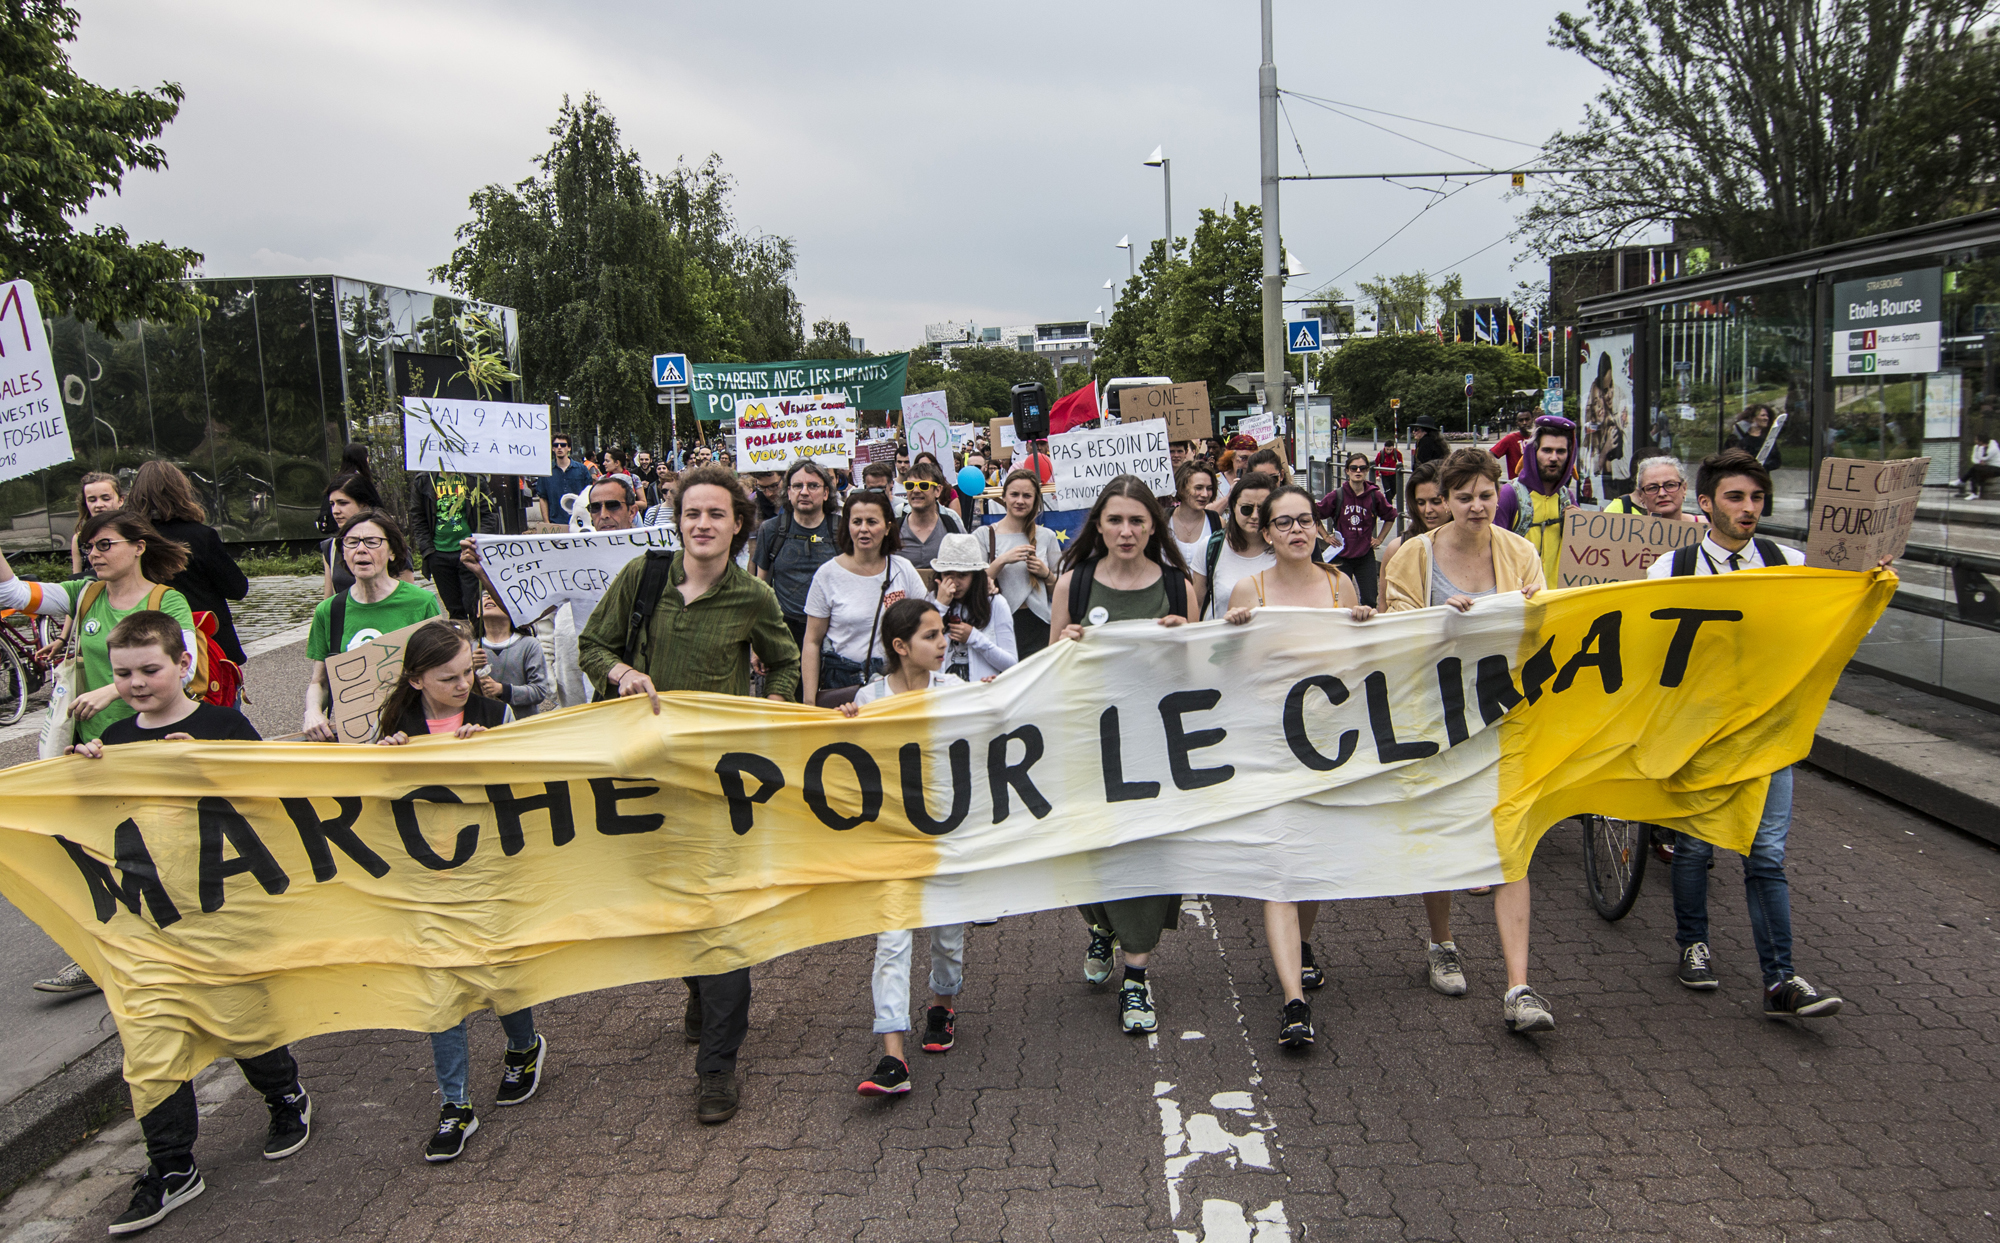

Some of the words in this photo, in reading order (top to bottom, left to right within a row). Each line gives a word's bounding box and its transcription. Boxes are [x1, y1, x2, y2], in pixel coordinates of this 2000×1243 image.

[1866, 277, 1903, 291] STRASBOURG
[1848, 300, 1879, 320] Etoile
[1880, 298, 1922, 316] Bourse
[1849, 337, 1863, 346] tram
[1865, 332, 1874, 348] A
[1878, 335, 1890, 343] Parc
[1891, 333, 1901, 342] des
[1902, 332, 1921, 343] Sports
[1849, 360, 1863, 368] tram
[1865, 355, 1874, 371] D
[1877, 358, 1900, 367] Poteries
[0, 370, 43, 401] ALES
[692, 373, 715, 391] LES
[717, 371, 768, 390] PARENTS
[773, 369, 805, 388] AVEC
[809, 367, 830, 386] LES
[835, 364, 888, 382] ENFANTS
[778, 400, 817, 415] VENEZ
[1147, 387, 1185, 408] ONE
[0, 398, 50, 425] VESTIS
[473, 407, 486, 427] 9
[501, 410, 548, 431] ANS
[3, 416, 64, 450] FOSSILE
[771, 418, 798, 429] VOUS
[806, 428, 843, 440] COMME
[489, 439, 500, 454] À
[508, 443, 537, 457] MOI
[749, 448, 787, 465] VOUS
[794, 443, 847, 458] VOULEZ
[1051, 442, 1082, 460] PAS
[1087, 433, 1141, 458] BESOIN
[1146, 431, 1167, 452] DE
[1073, 460, 1127, 478] L'AVION
[1133, 457, 1168, 473] POUR
[1827, 463, 1865, 492] LE
[1569, 545, 1611, 567] VOS
[500, 559, 543, 581] C'EST
[506, 568, 612, 614] PROTEGER
[51, 777, 666, 930] MARCHE
[714, 723, 1053, 836] POUR
[1099, 688, 1236, 804] LE
[1283, 607, 1744, 772] CLIMAT
